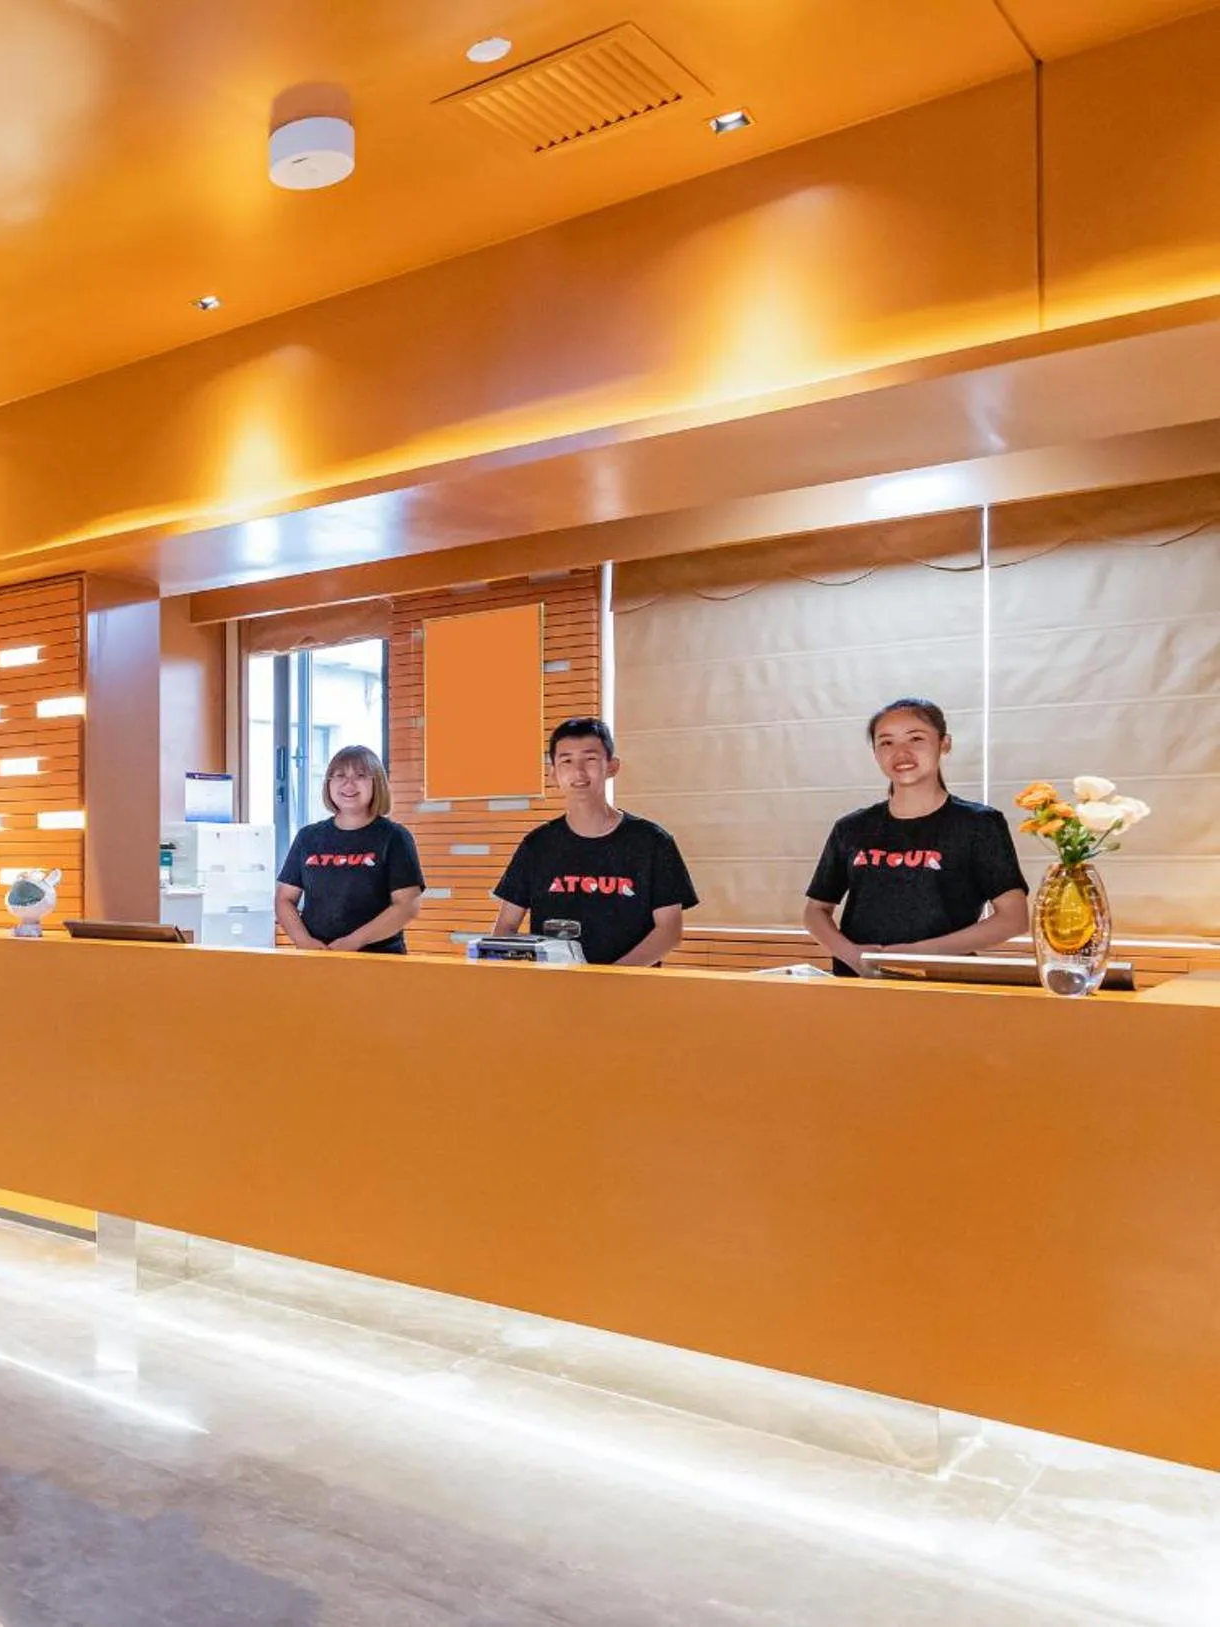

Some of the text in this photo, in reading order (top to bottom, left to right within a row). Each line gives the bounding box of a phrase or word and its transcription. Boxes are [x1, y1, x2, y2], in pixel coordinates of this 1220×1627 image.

[305, 852, 377, 866] ATOUR
[853, 848, 943, 870] ATOUR
[548, 875, 636, 897] ATOUR
